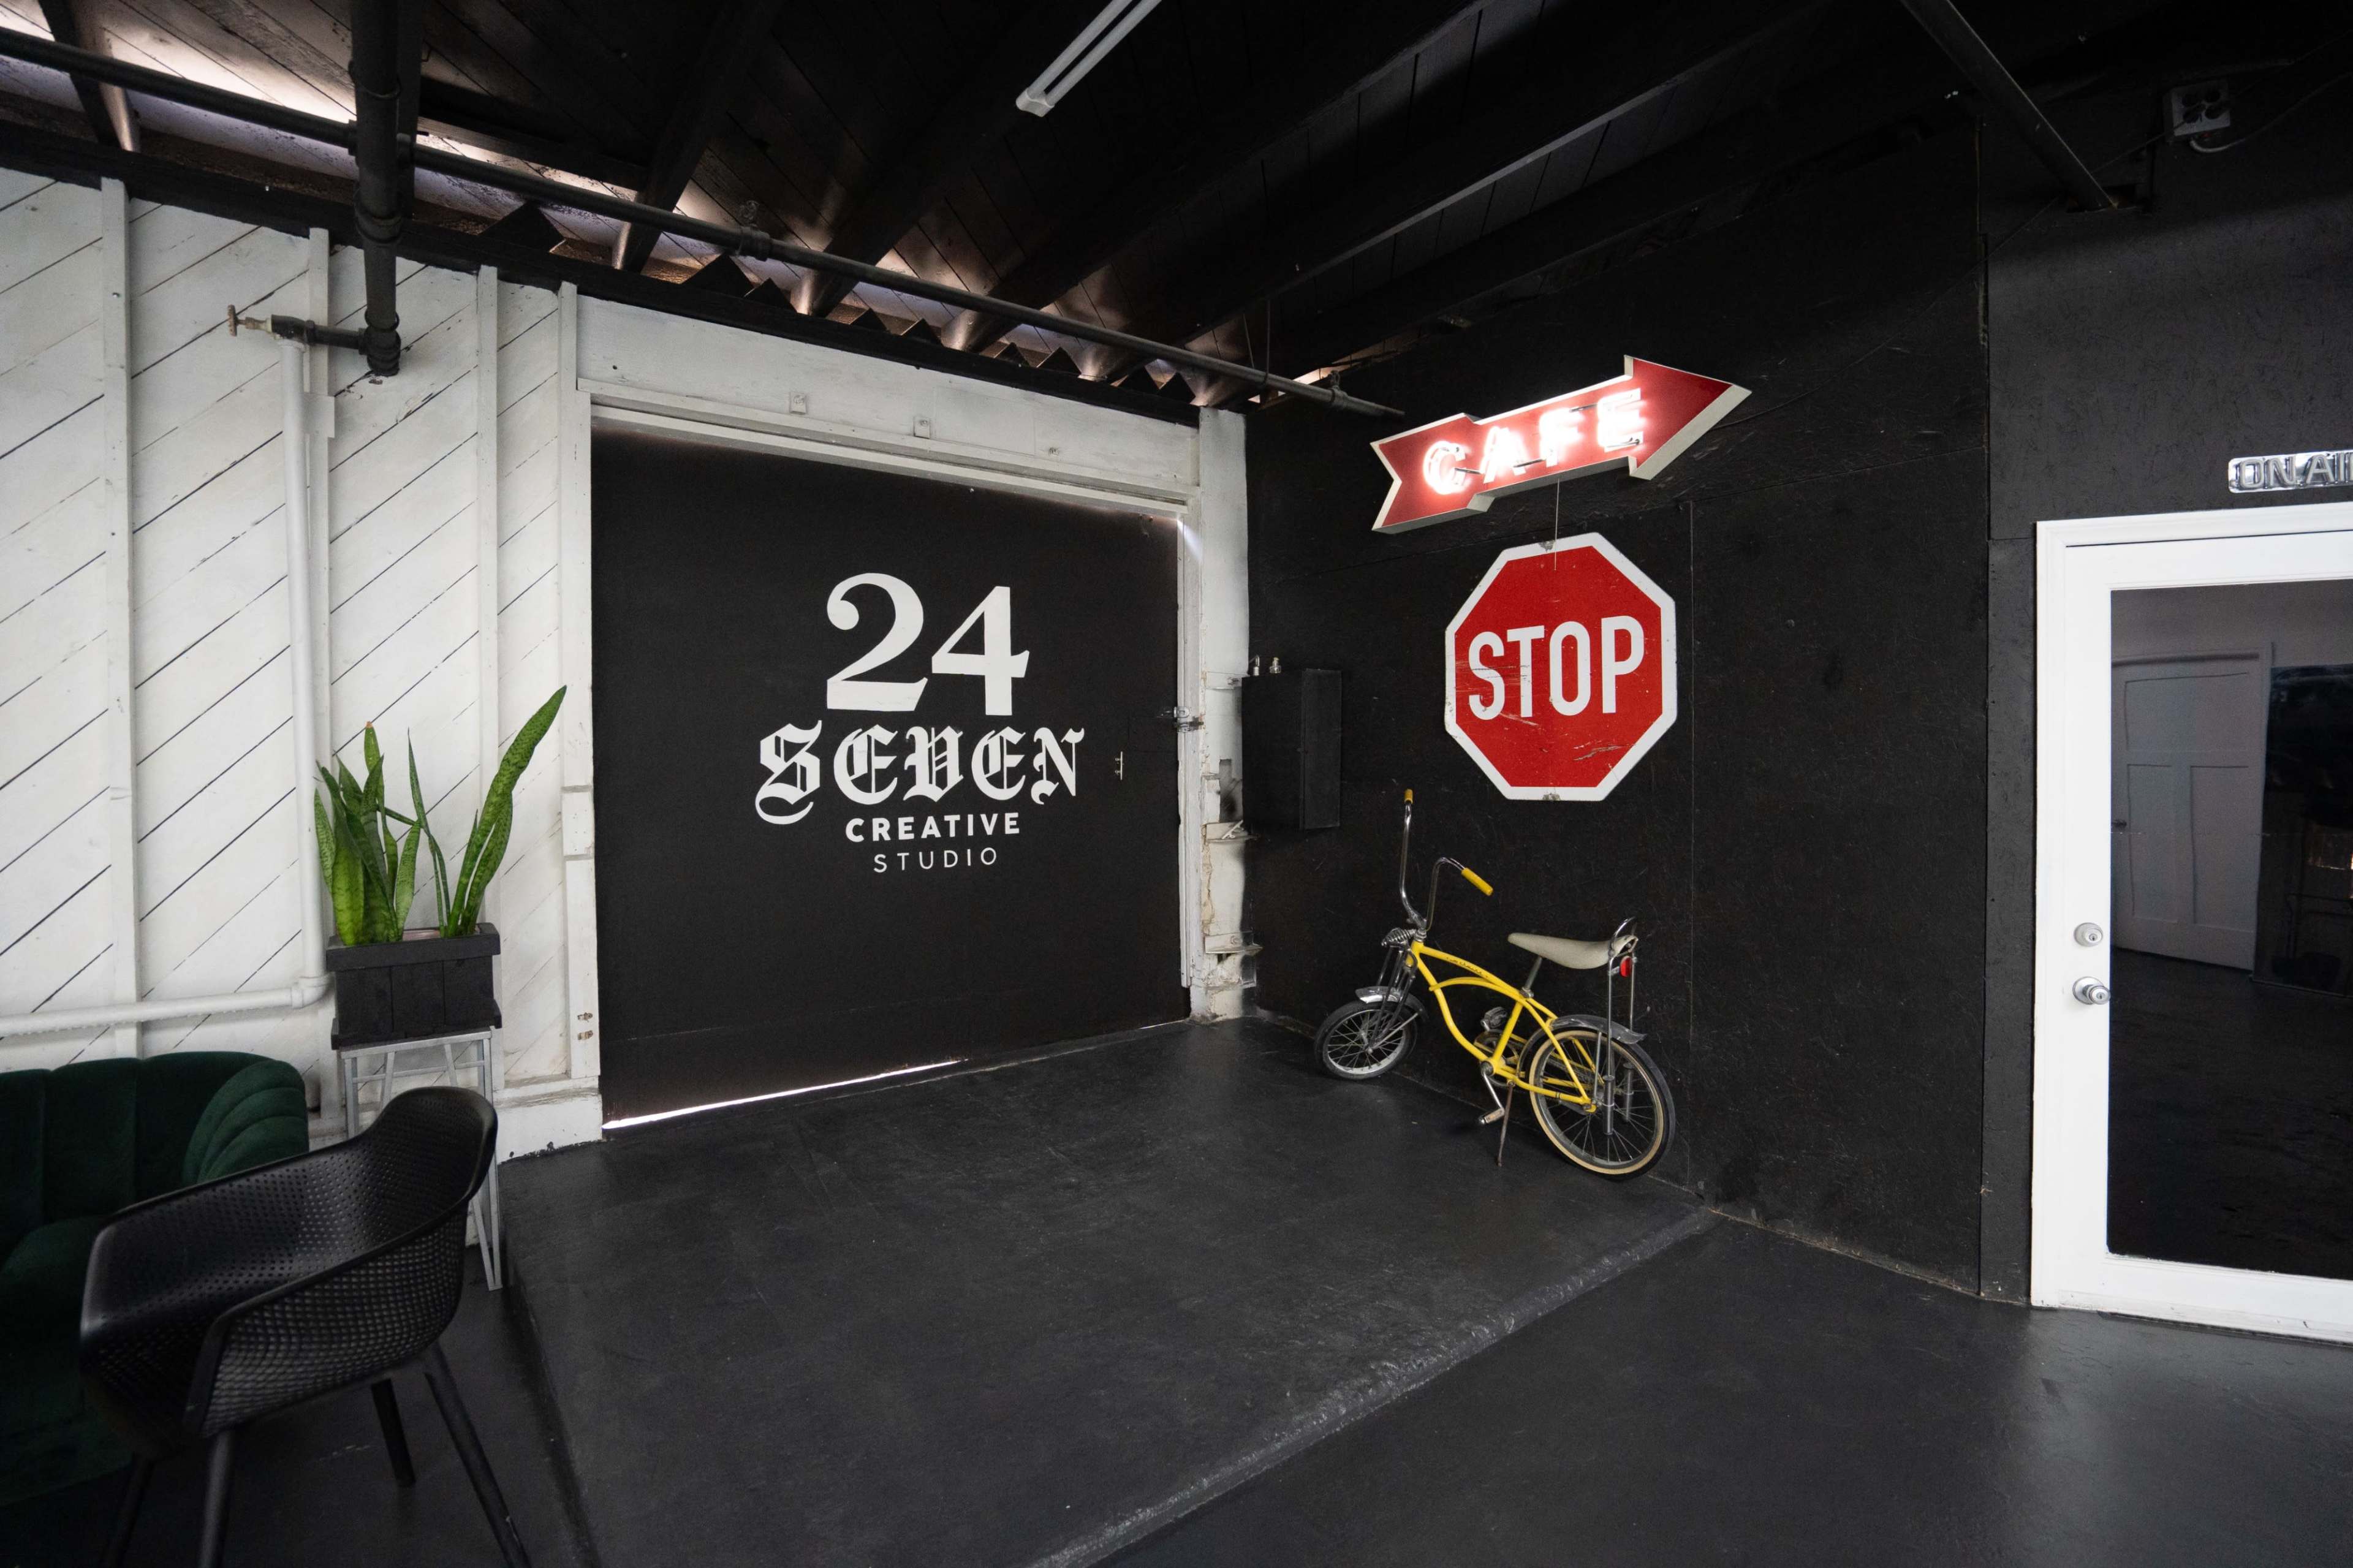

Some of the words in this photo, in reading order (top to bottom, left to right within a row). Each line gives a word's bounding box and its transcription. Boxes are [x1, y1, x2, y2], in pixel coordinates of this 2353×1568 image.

[1423, 387, 1646, 494] CAFE
[2238, 456, 2297, 489] ON
[827, 572, 1030, 716] 24
[1468, 615, 1645, 721] STOP
[754, 719, 1085, 825] SEVEN
[845, 812, 1020, 843] CREATIVE
[873, 847, 997, 873] STUDIO
